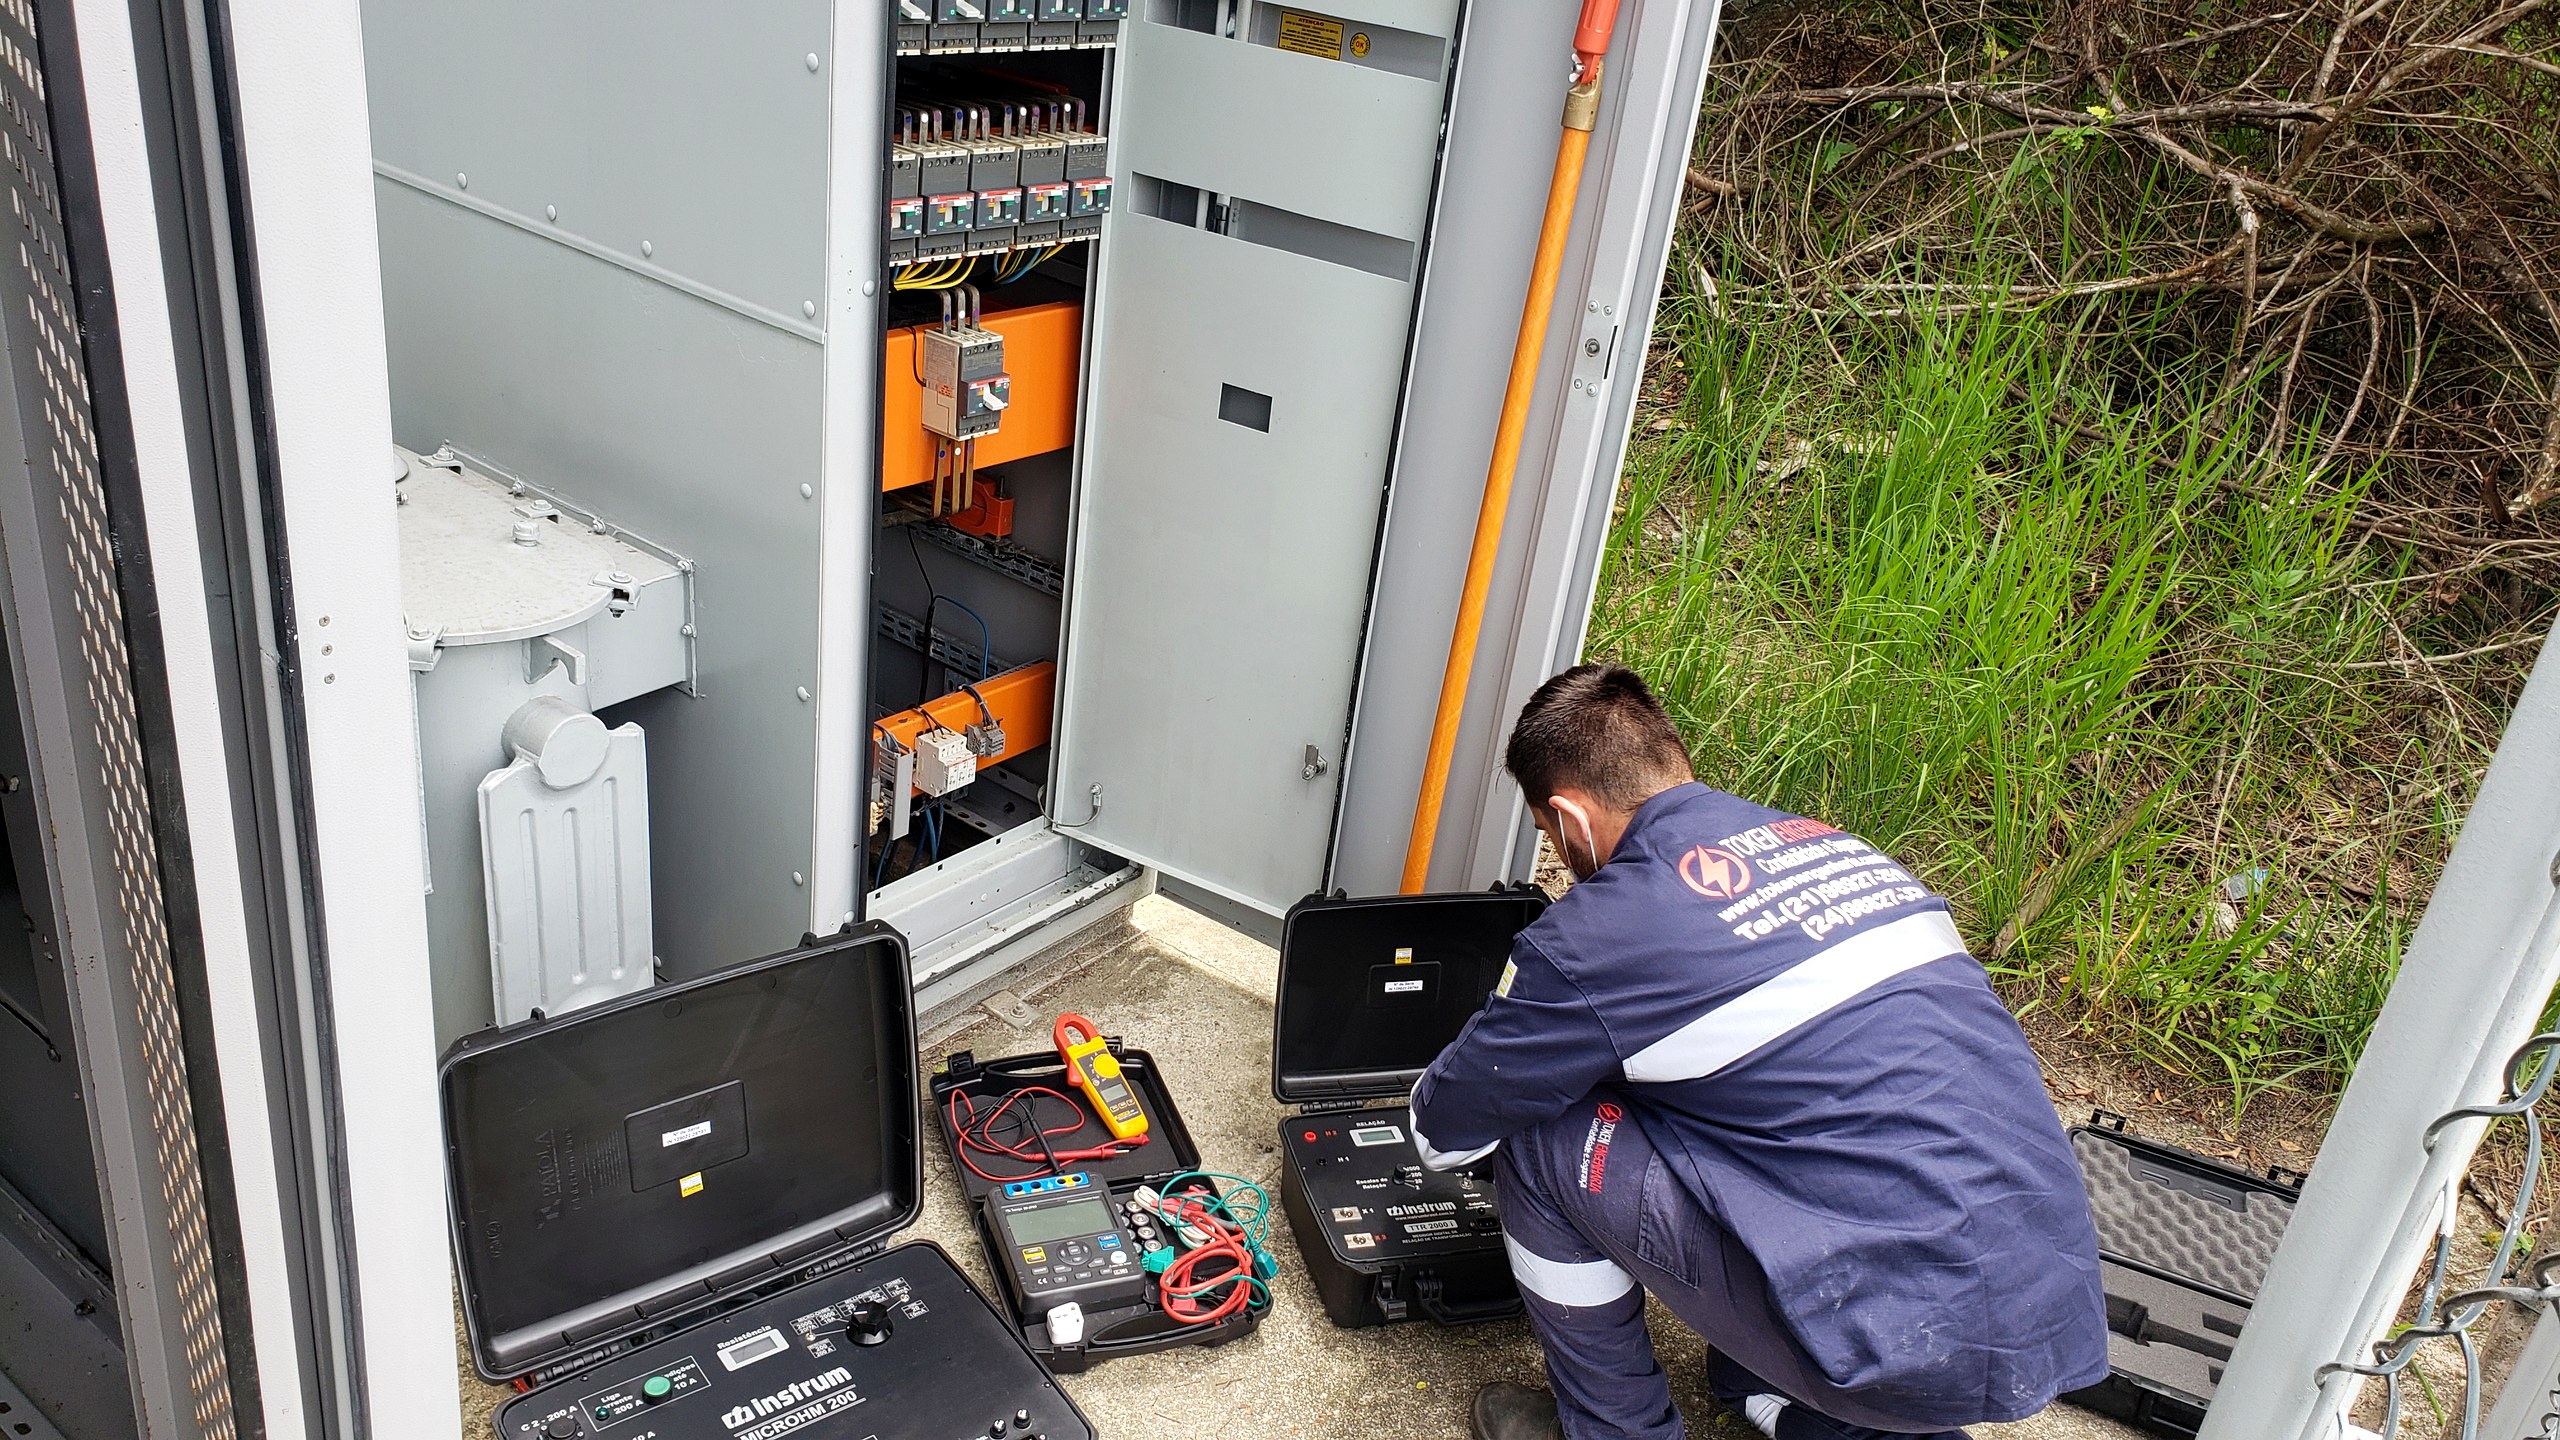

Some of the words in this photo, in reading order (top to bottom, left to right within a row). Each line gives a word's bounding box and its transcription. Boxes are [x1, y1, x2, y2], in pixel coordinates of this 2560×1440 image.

[1355, 40, 1365, 49] OK
[1718, 824, 1785, 860] TOKEN
[1356, 1120, 1386, 1128] RELAÇÃO
[1597, 1121, 1616, 1146] TOKEN
[1589, 1142, 1609, 1195] ENGENHARIA
[1429, 1221, 1449, 1229] 2000
[716, 1325, 772, 1350] Resistência
[674, 1381, 688, 1390] 10
[689, 1377, 698, 1385] A
[600, 1392, 621, 1404] Liga
[613, 1402, 634, 1415] 200
[634, 1399, 644, 1407] A
[739, 1402, 827, 1440] MICROHM
[826, 1390, 858, 1410] 200
[520, 1423, 531, 1432] C
[531, 1420, 541, 1428] 2
[546, 1409, 567, 1422] 200
[569, 1405, 579, 1413] A
[646, 1430, 656, 1439] A
